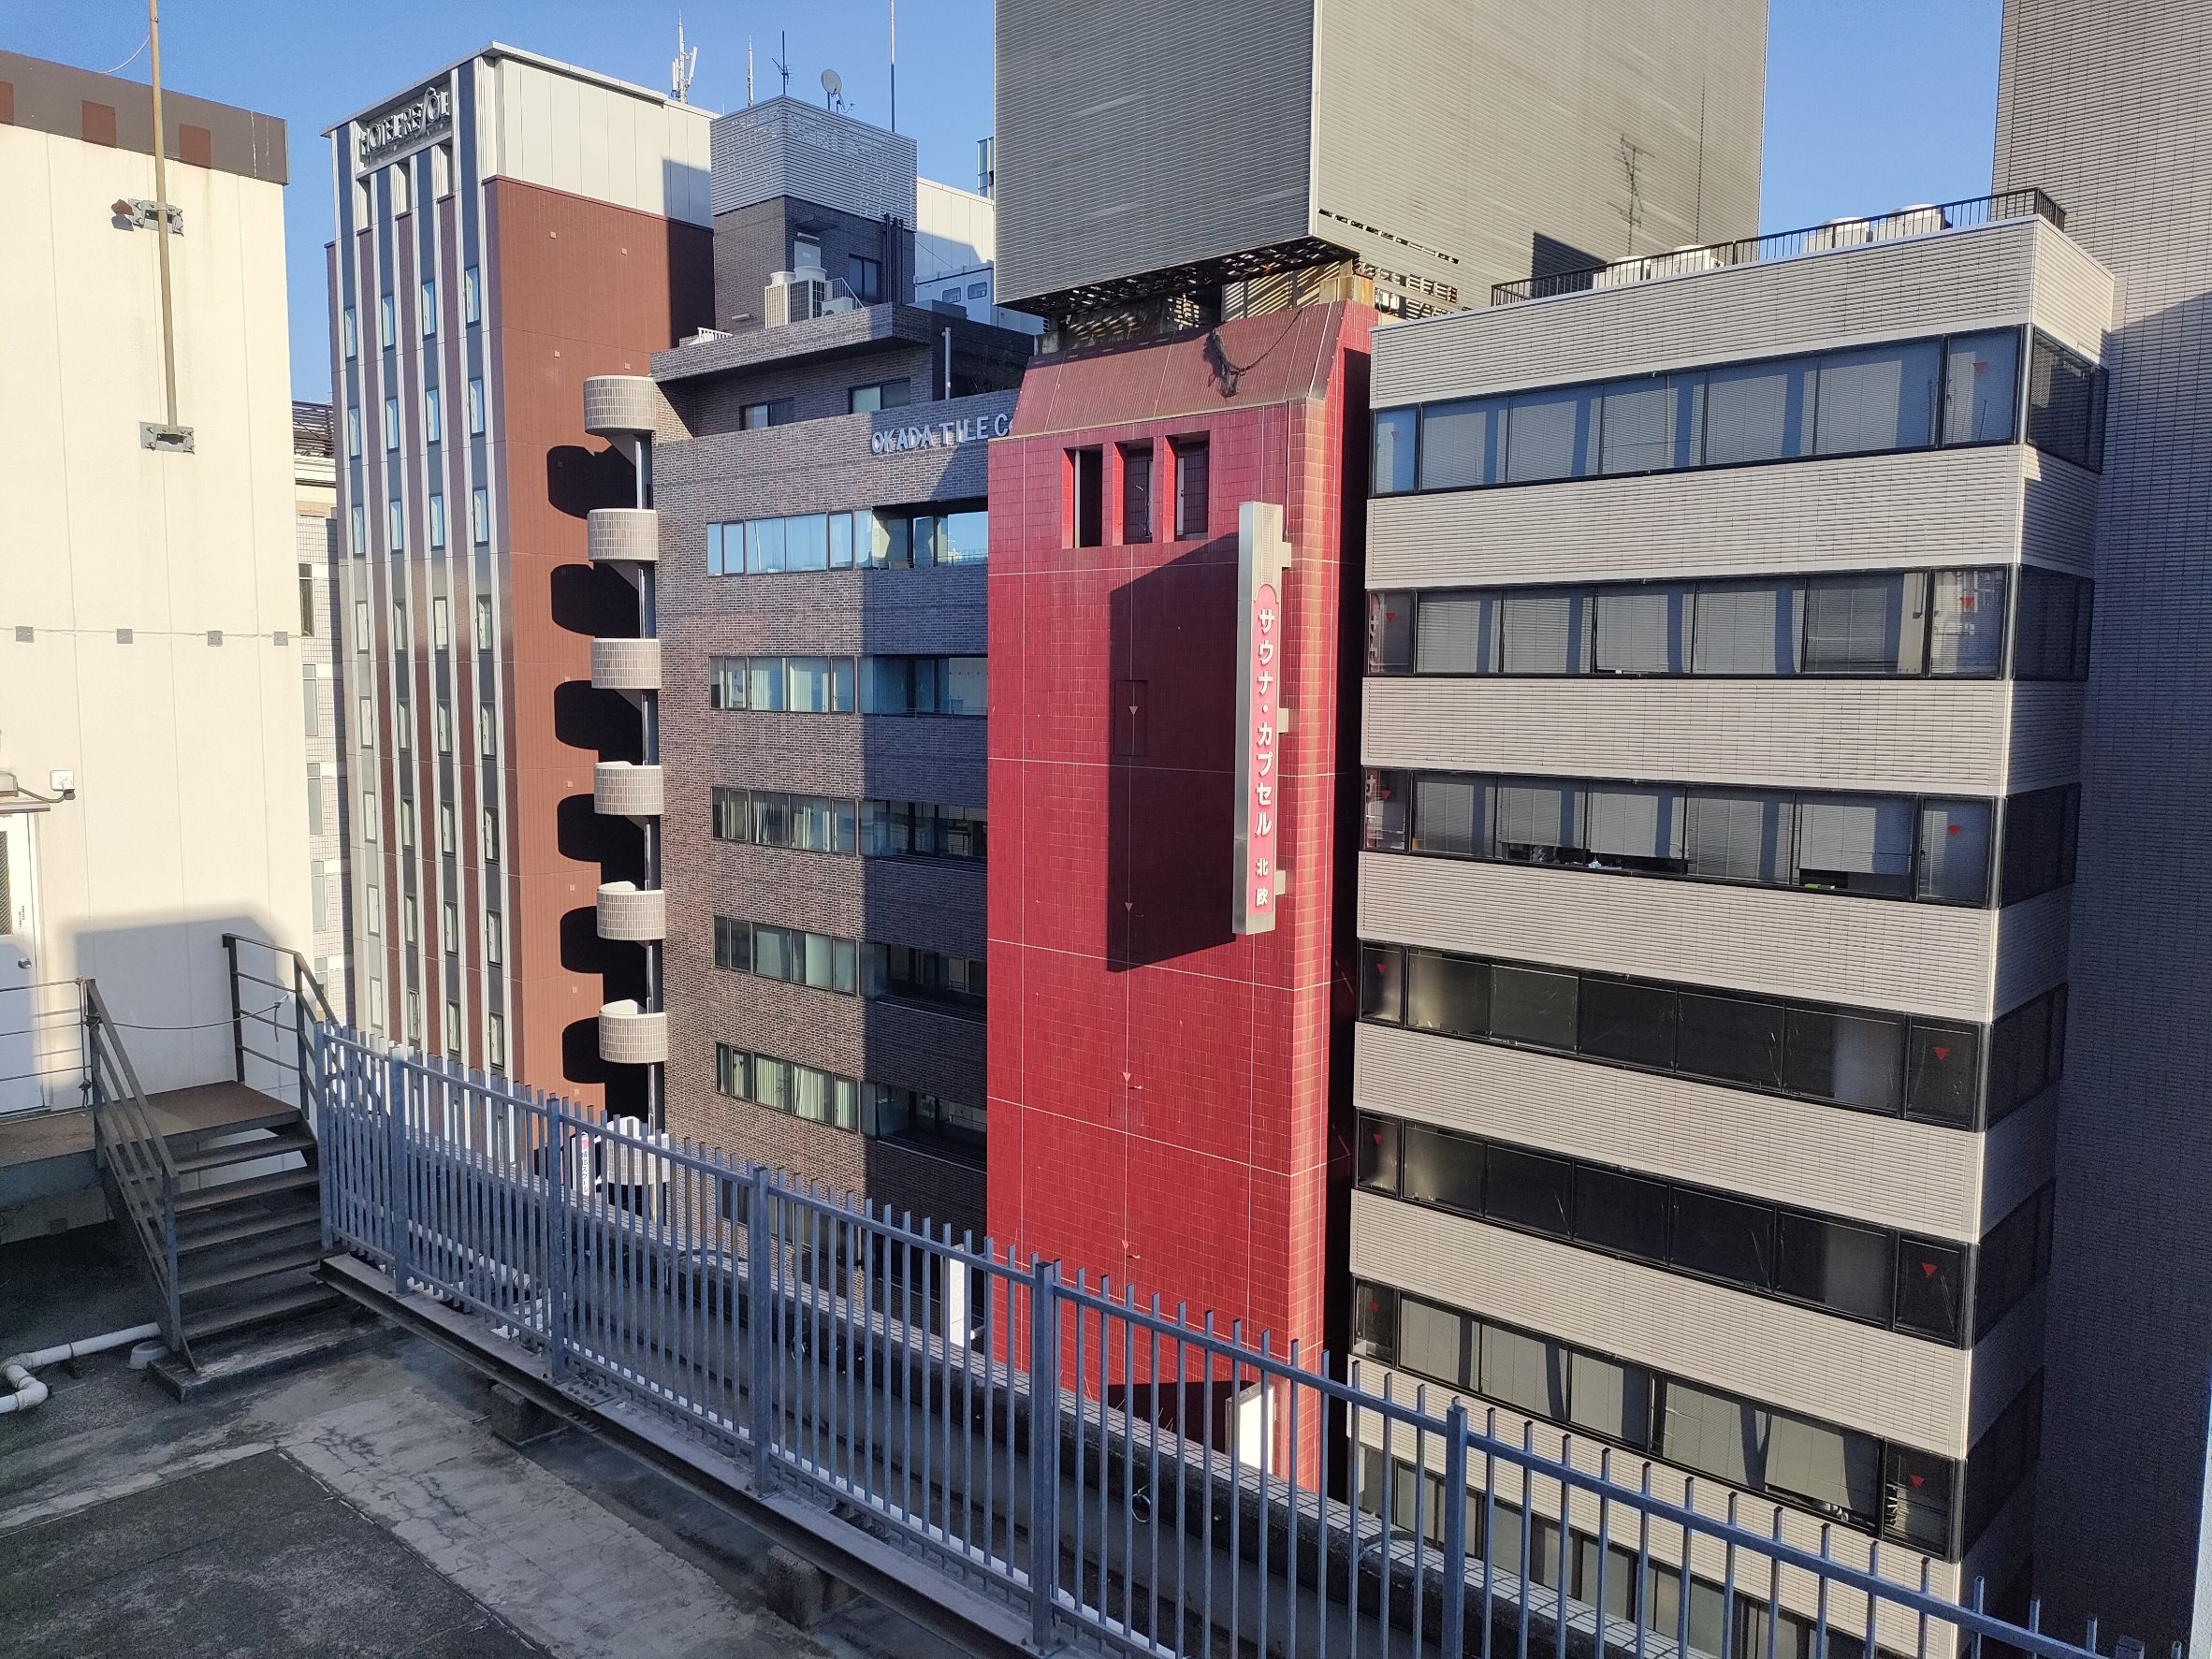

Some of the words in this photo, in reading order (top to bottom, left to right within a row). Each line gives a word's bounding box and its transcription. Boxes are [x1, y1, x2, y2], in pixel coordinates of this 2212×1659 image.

[871, 426, 934, 455] OKADA
[939, 415, 989, 444] TILE
[994, 413, 1013, 437] C
[1256, 608, 1275, 837] サウナ・カプセル
[1256, 858, 1270, 908] 北欧
